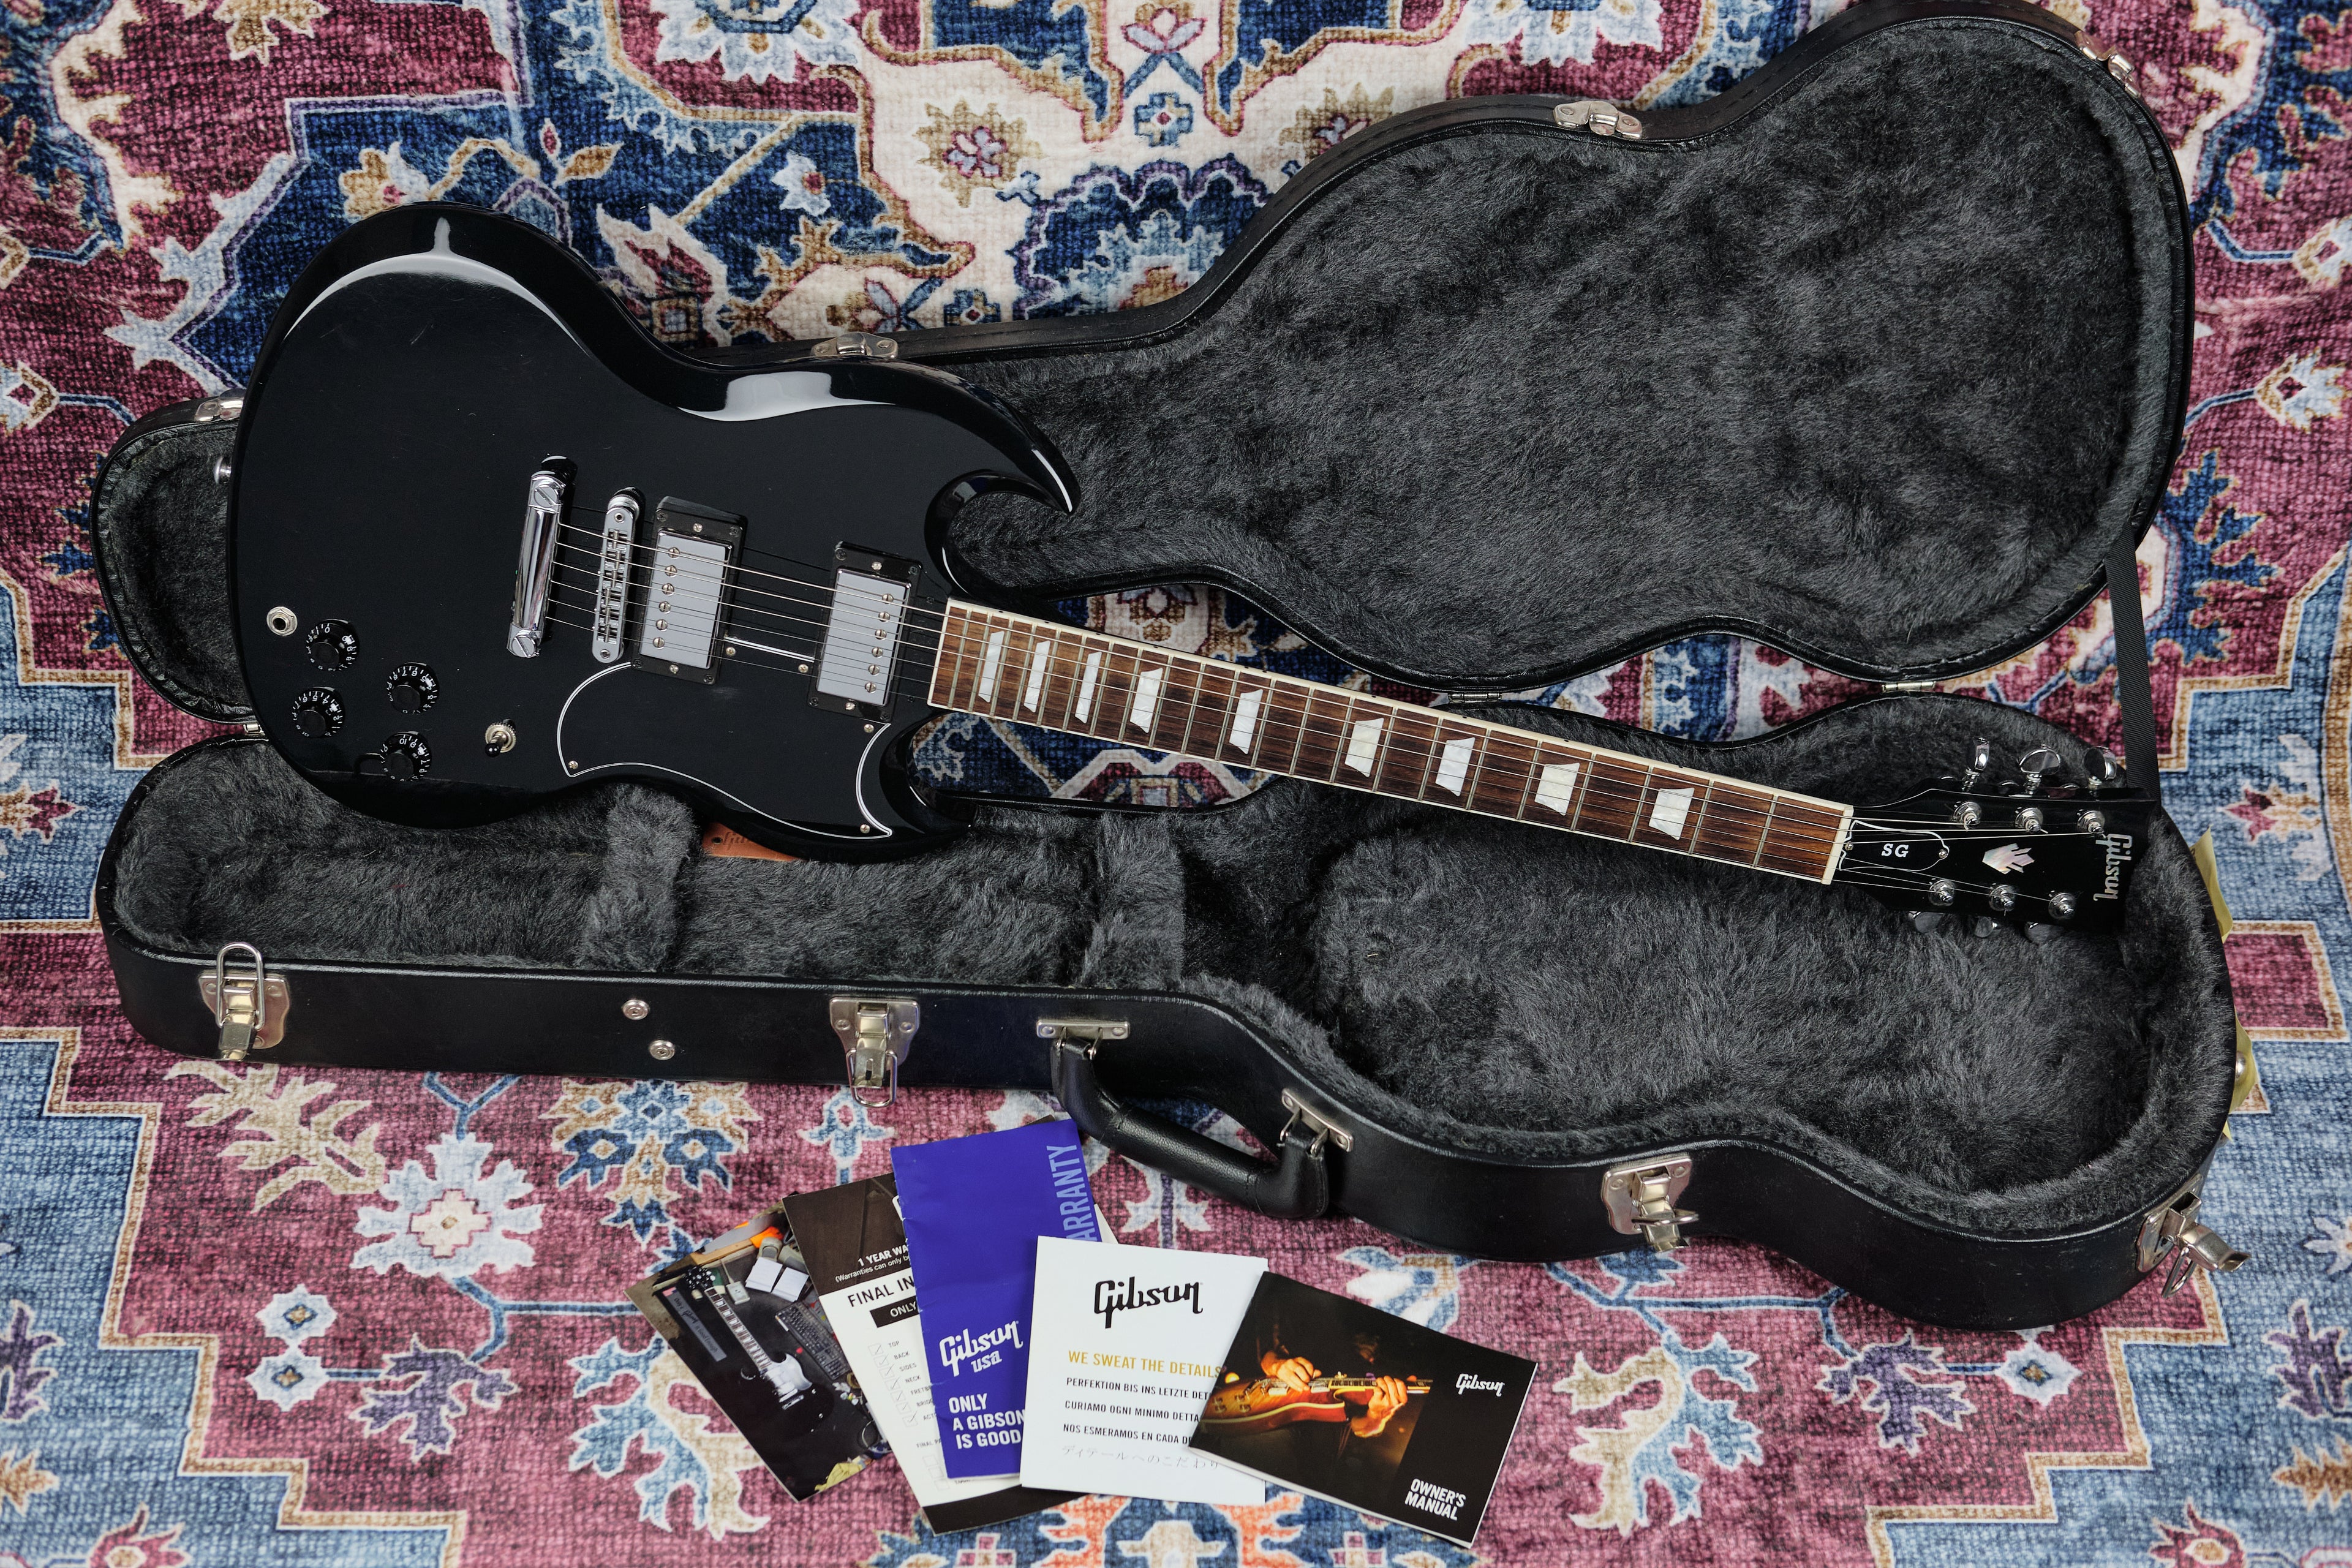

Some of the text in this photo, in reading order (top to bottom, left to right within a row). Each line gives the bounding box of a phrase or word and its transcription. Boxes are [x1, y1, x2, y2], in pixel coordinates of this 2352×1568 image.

[1882, 843, 1909, 858] SG
[2093, 834, 2133, 902] Gibson
[858, 1257, 864, 1267] 1
[866, 1250, 892, 1264] YEAR
[835, 1267, 873, 1283] (Warranties
[888, 1257, 902, 1266] only
[848, 1284, 894, 1307] FINAL
[1094, 1276, 1204, 1329] Gibson
[890, 1301, 917, 1317] ONLY
[894, 1351, 910, 1360] BACK
[939, 1321, 1023, 1377] Gibson
[899, 1363, 917, 1371] SIDES
[1068, 1351, 1221, 1379] WE SWEAT THE DETAILS
[1066, 1377, 1211, 1401] PERFEKTION BIS INS LETZTE DET
[1456, 1373, 1505, 1397] Gibson
[949, 1393, 988, 1414] ONLY
[1065, 1400, 1200, 1422] CURIAMO OGNI MINIMO DETTA
[953, 1409, 1025, 1431] A GIBSON
[956, 1429, 1022, 1449] IS GOOD
[1063, 1423, 1080, 1433] NOS
[1084, 1426, 1139, 1439] ESMERAMOS
[1142, 1431, 1153, 1441] EN
[1156, 1433, 1179, 1444] CADA
[1411, 1478, 1466, 1508] OWNER'S
[1404, 1490, 1459, 1520] MANUAL
